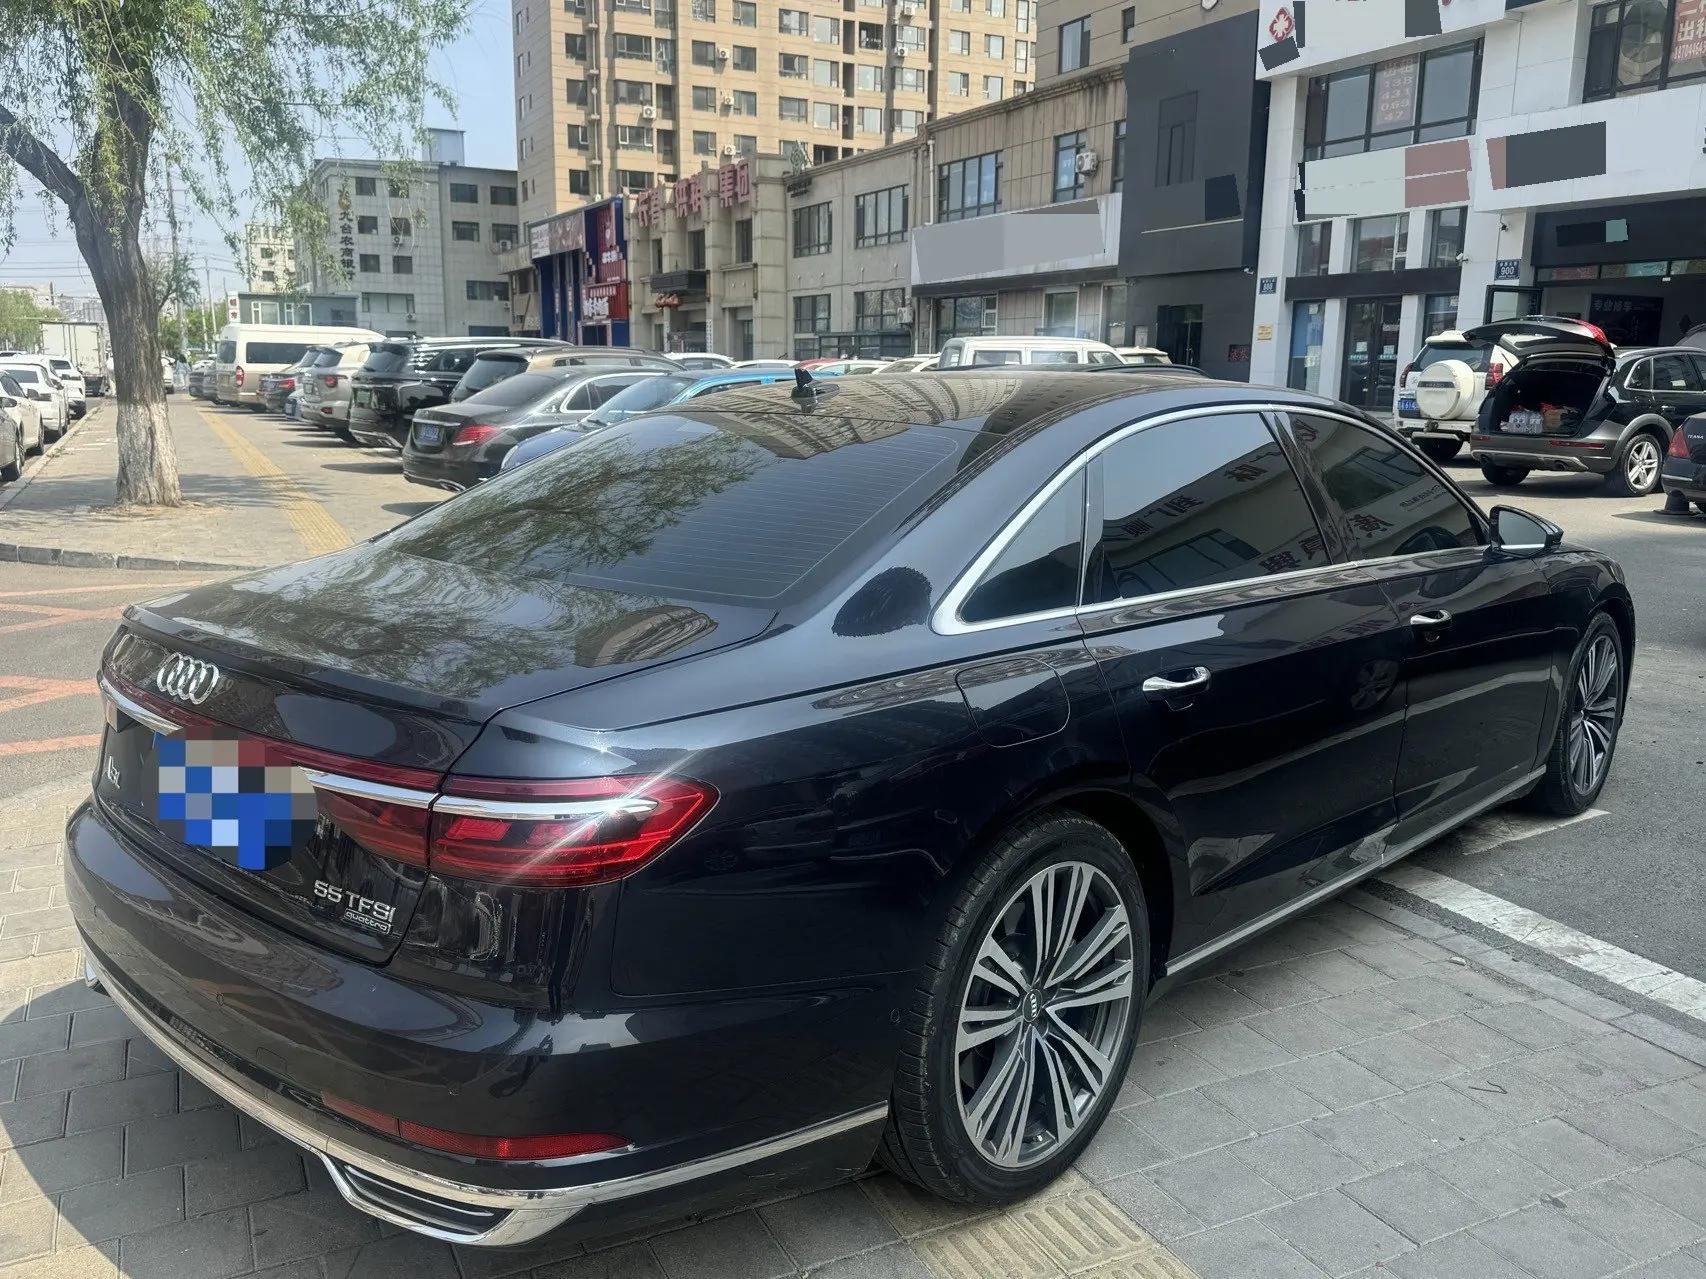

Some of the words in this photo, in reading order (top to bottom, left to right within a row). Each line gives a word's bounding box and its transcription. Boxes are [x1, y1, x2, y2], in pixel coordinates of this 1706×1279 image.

[1500, 266, 1515, 275] 900
[313, 879, 343, 904] 55
[345, 890, 397, 924] TFSI
[344, 910, 388, 932] quattro
